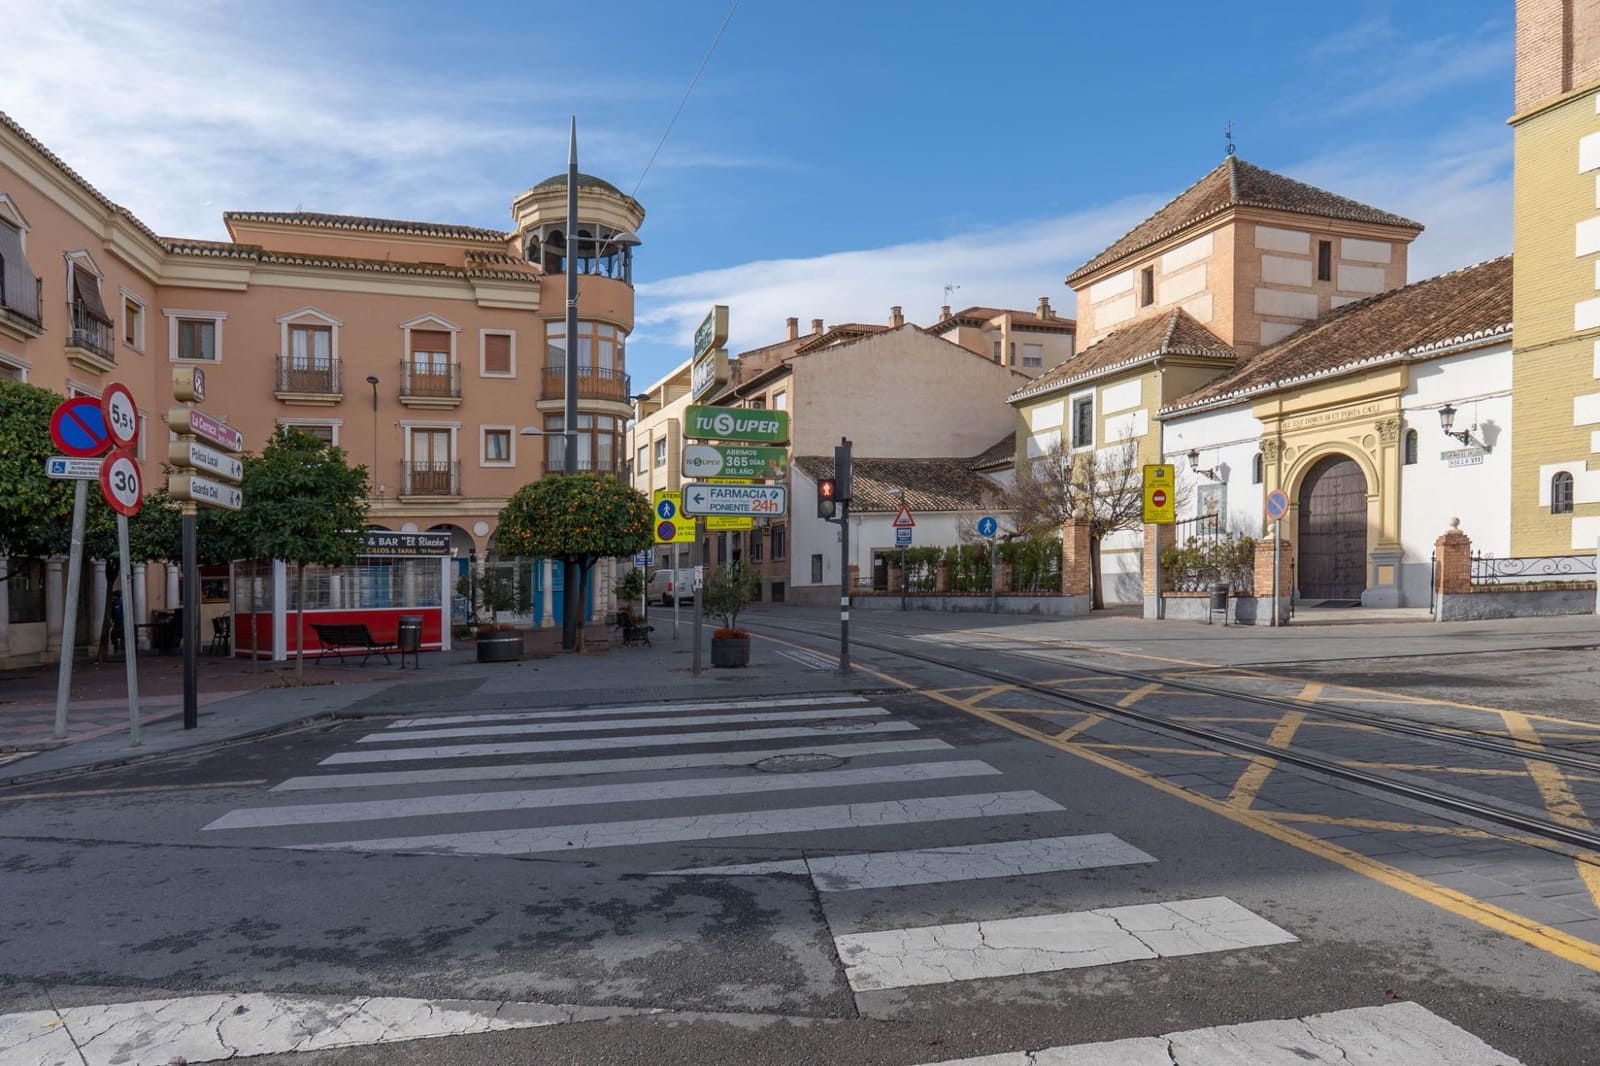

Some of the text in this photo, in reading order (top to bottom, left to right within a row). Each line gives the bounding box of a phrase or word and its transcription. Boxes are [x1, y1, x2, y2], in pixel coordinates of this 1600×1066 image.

[696, 414, 779, 435] TU SUPER
[726, 456, 749, 467] 365
[739, 467, 754, 475] AÑO
[114, 471, 136, 494] 30
[710, 488, 768, 499] FARMACIA
[710, 499, 779, 513] PONIENTE 24h
[378, 538, 399, 547] BAR
